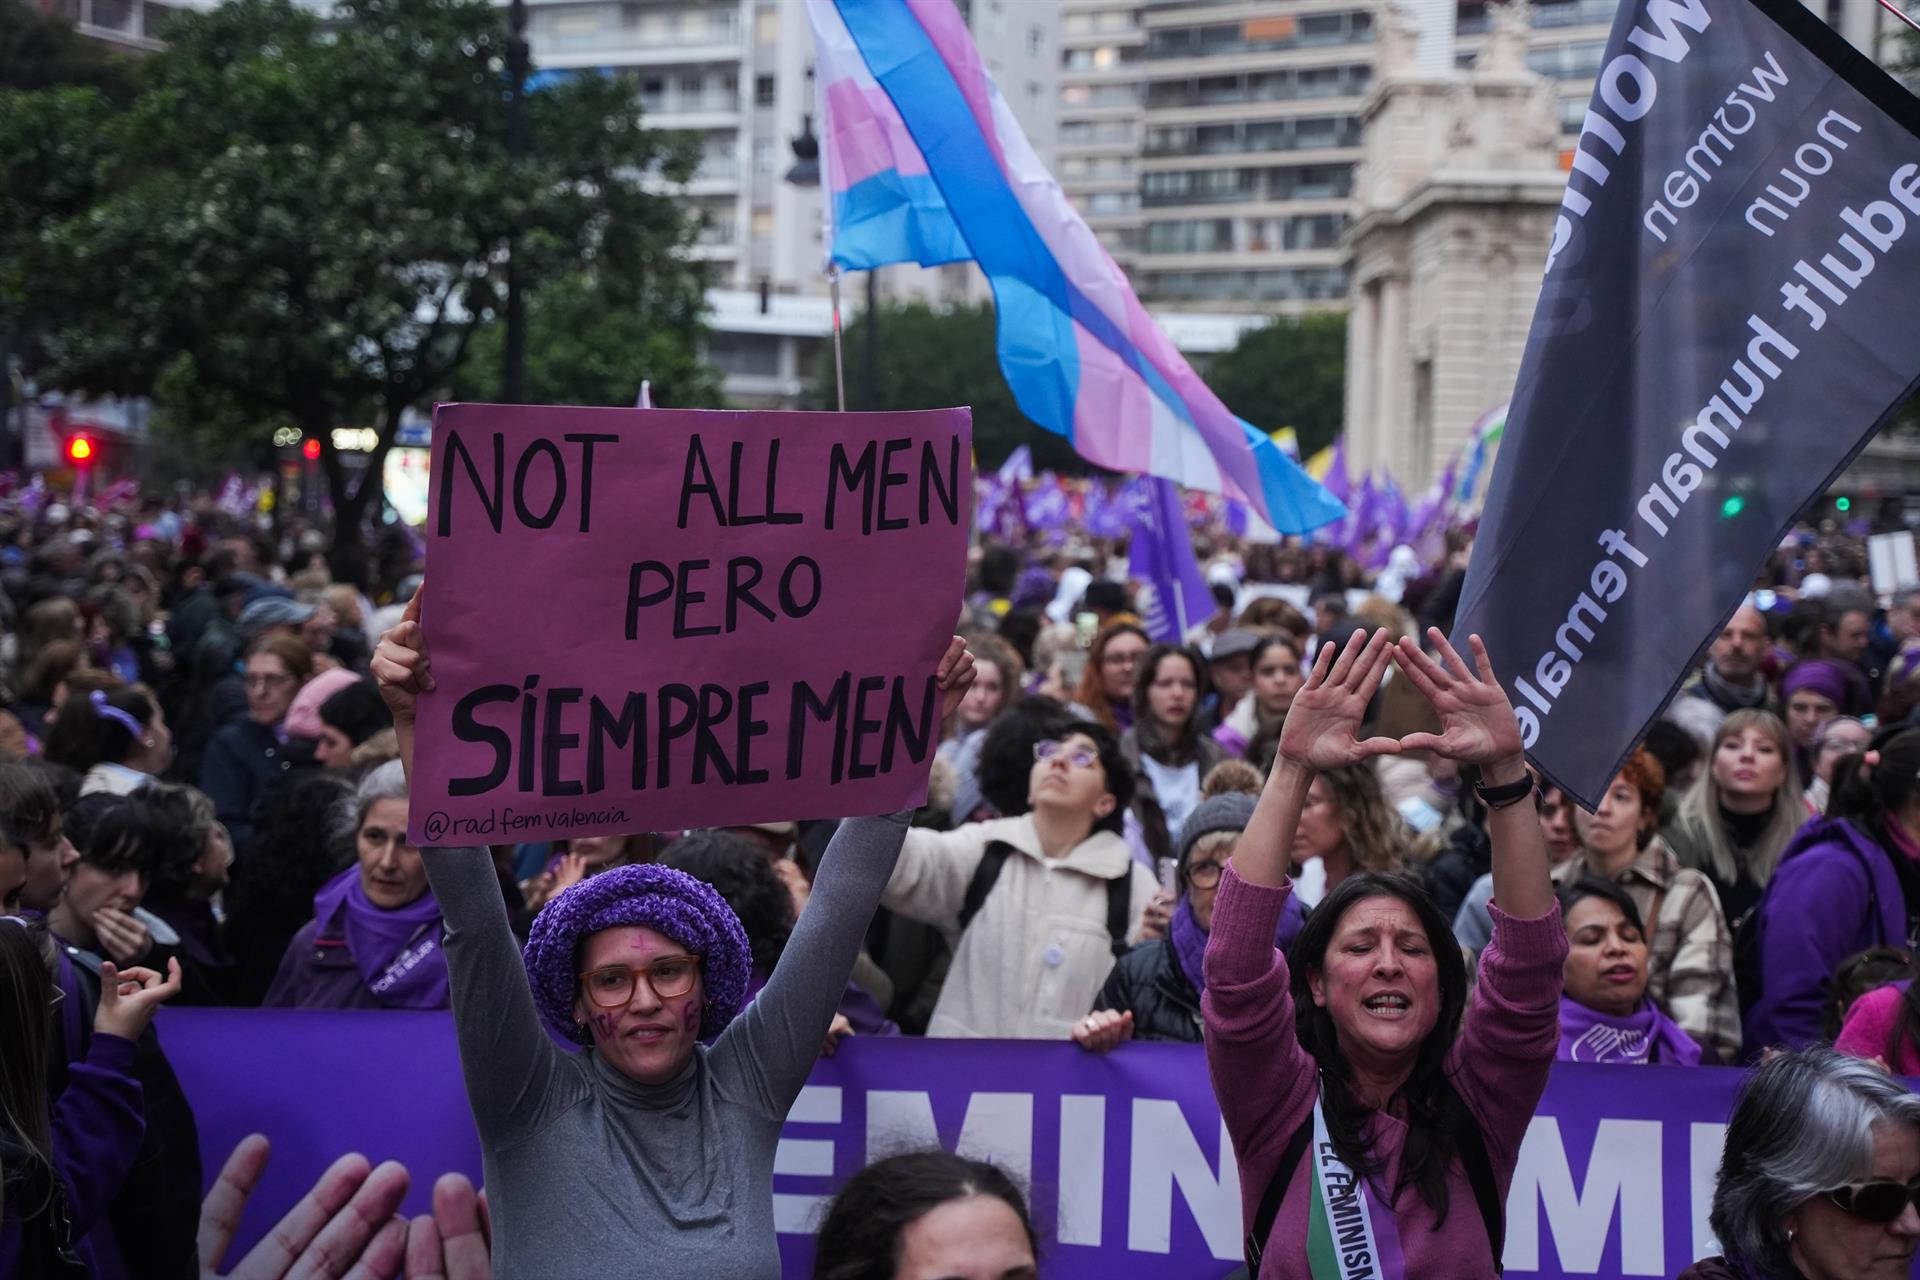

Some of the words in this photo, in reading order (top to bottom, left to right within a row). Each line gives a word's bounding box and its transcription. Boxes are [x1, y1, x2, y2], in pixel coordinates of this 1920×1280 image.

[437, 429, 619, 537] NOT
[677, 433, 803, 529] ALL
[824, 434, 960, 535] MEN
[625, 555, 822, 640] PERO
[785, 671, 936, 785] MEN
